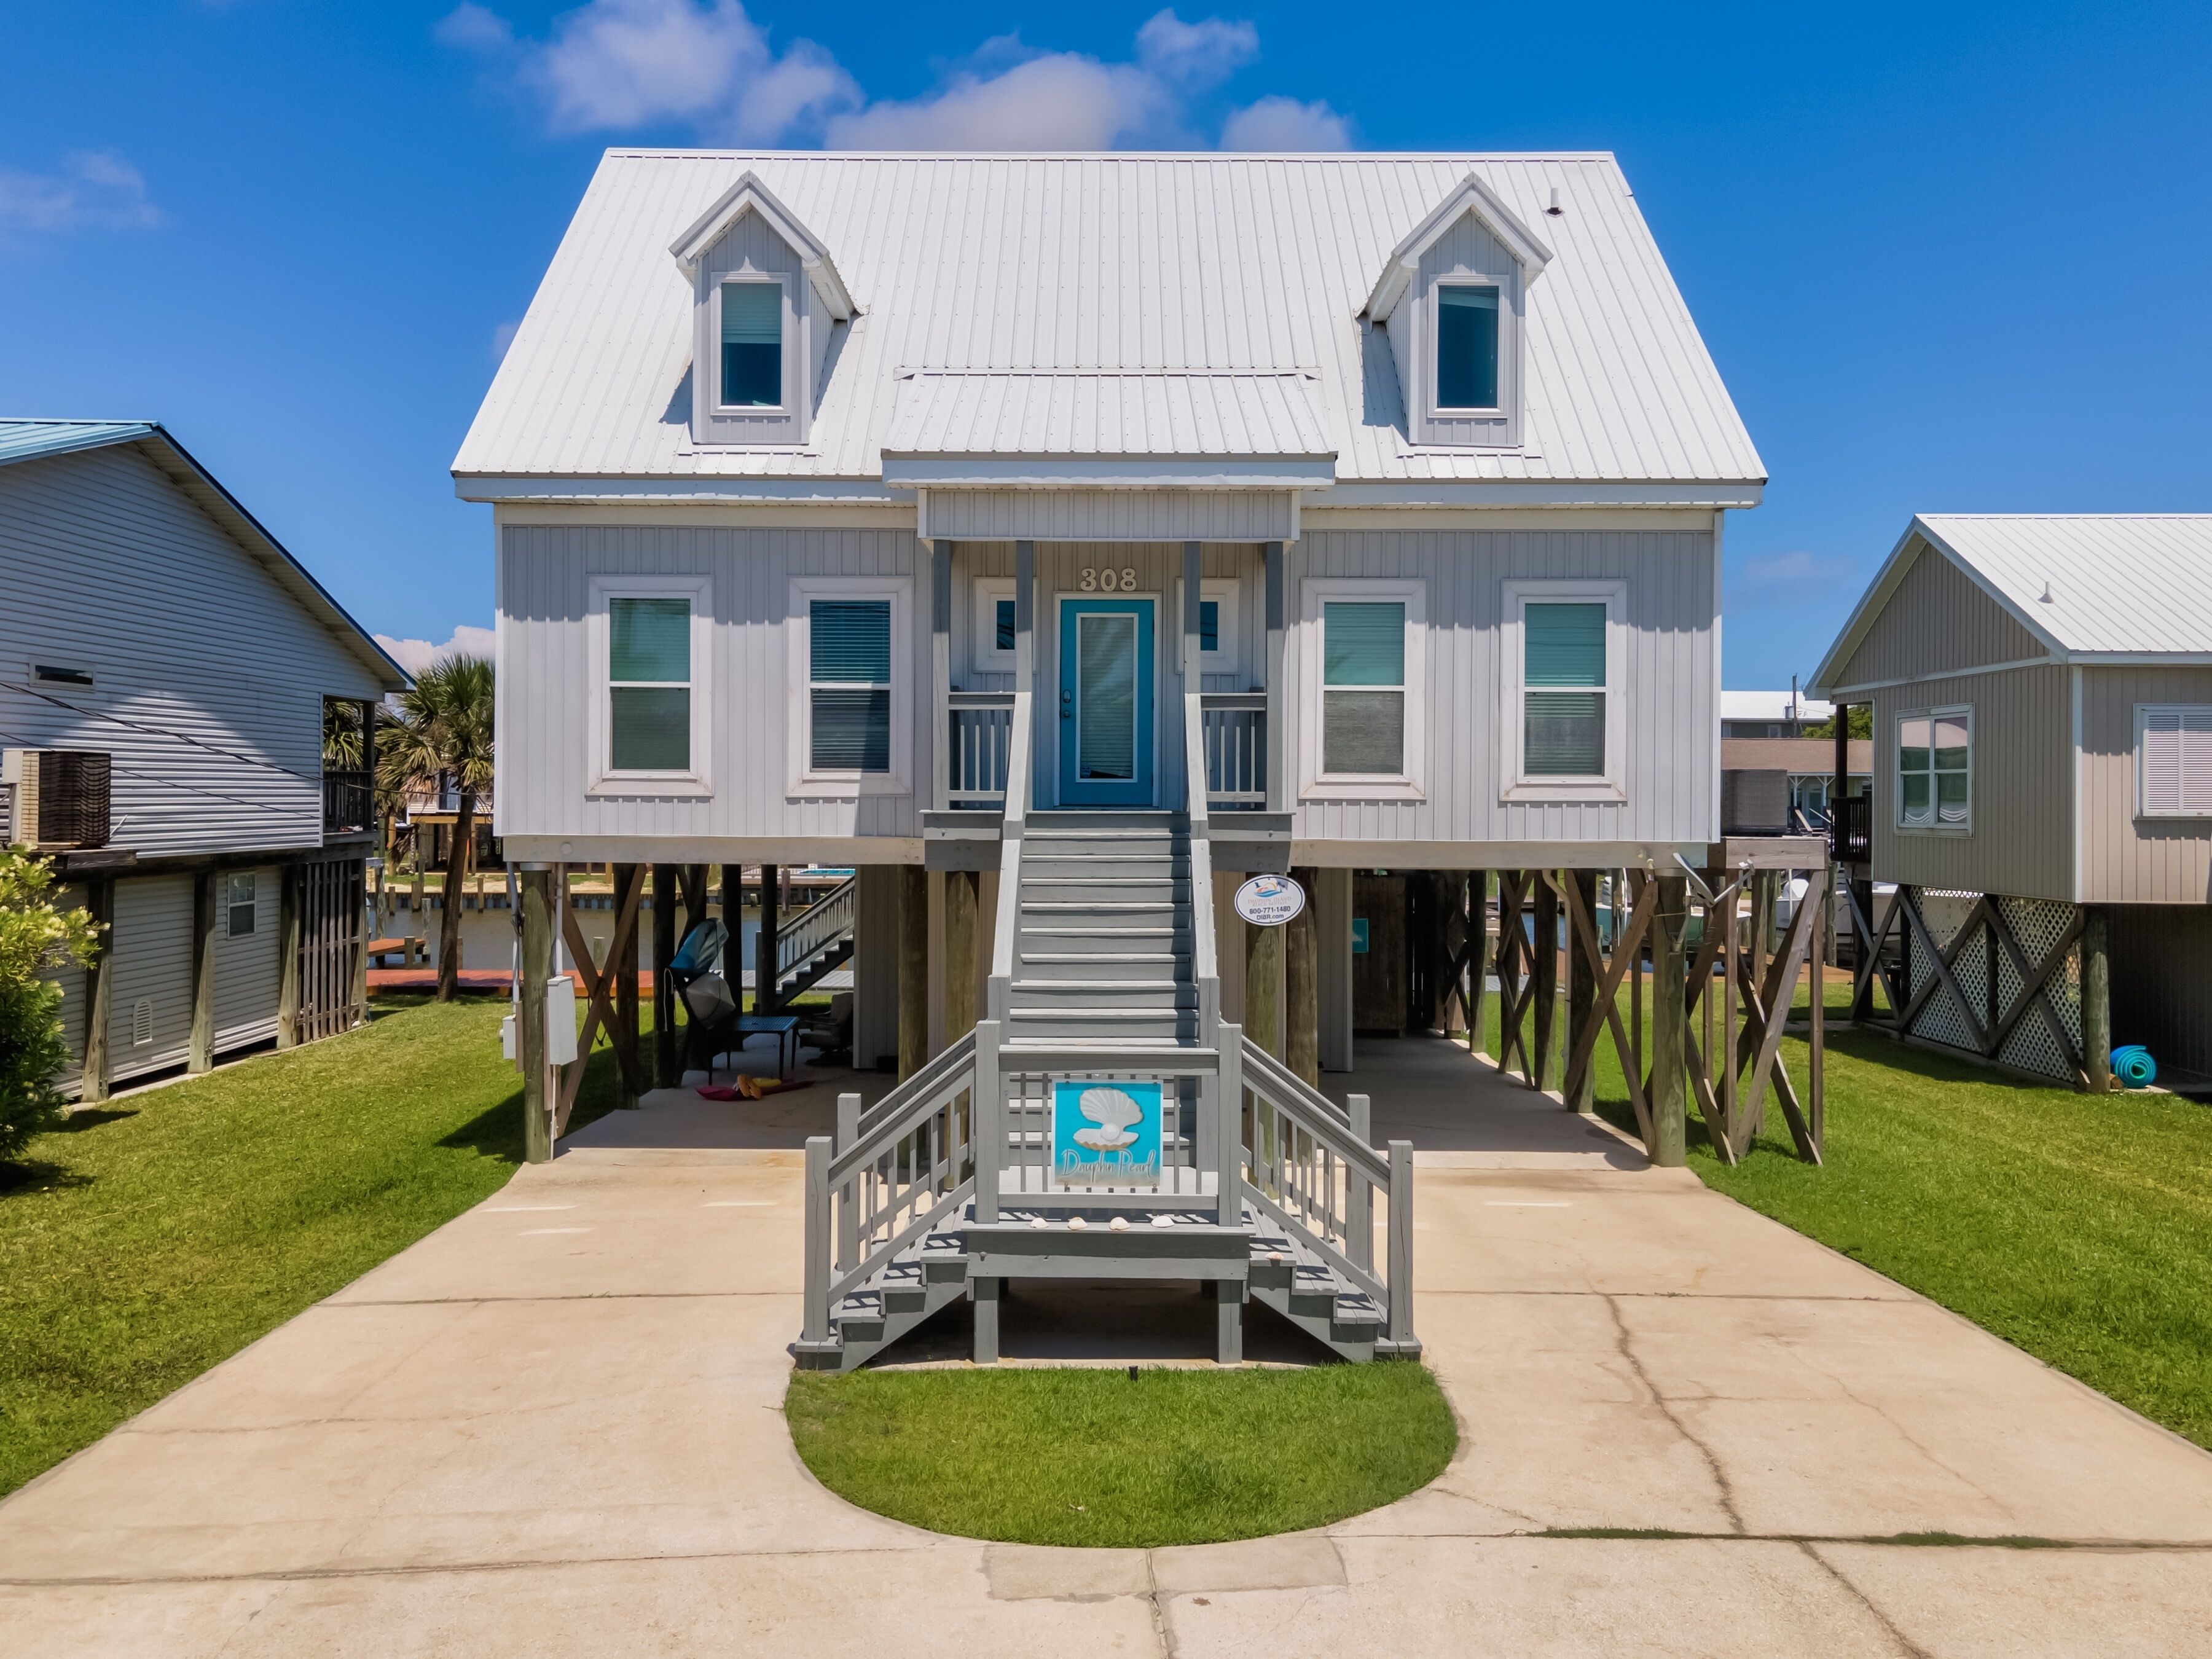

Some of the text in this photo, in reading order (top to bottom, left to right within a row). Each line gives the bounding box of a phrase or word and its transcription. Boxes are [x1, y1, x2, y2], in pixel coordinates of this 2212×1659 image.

[1080, 568, 1137, 591] 308
[1062, 1149, 1156, 1183] Dauphin Pearl
